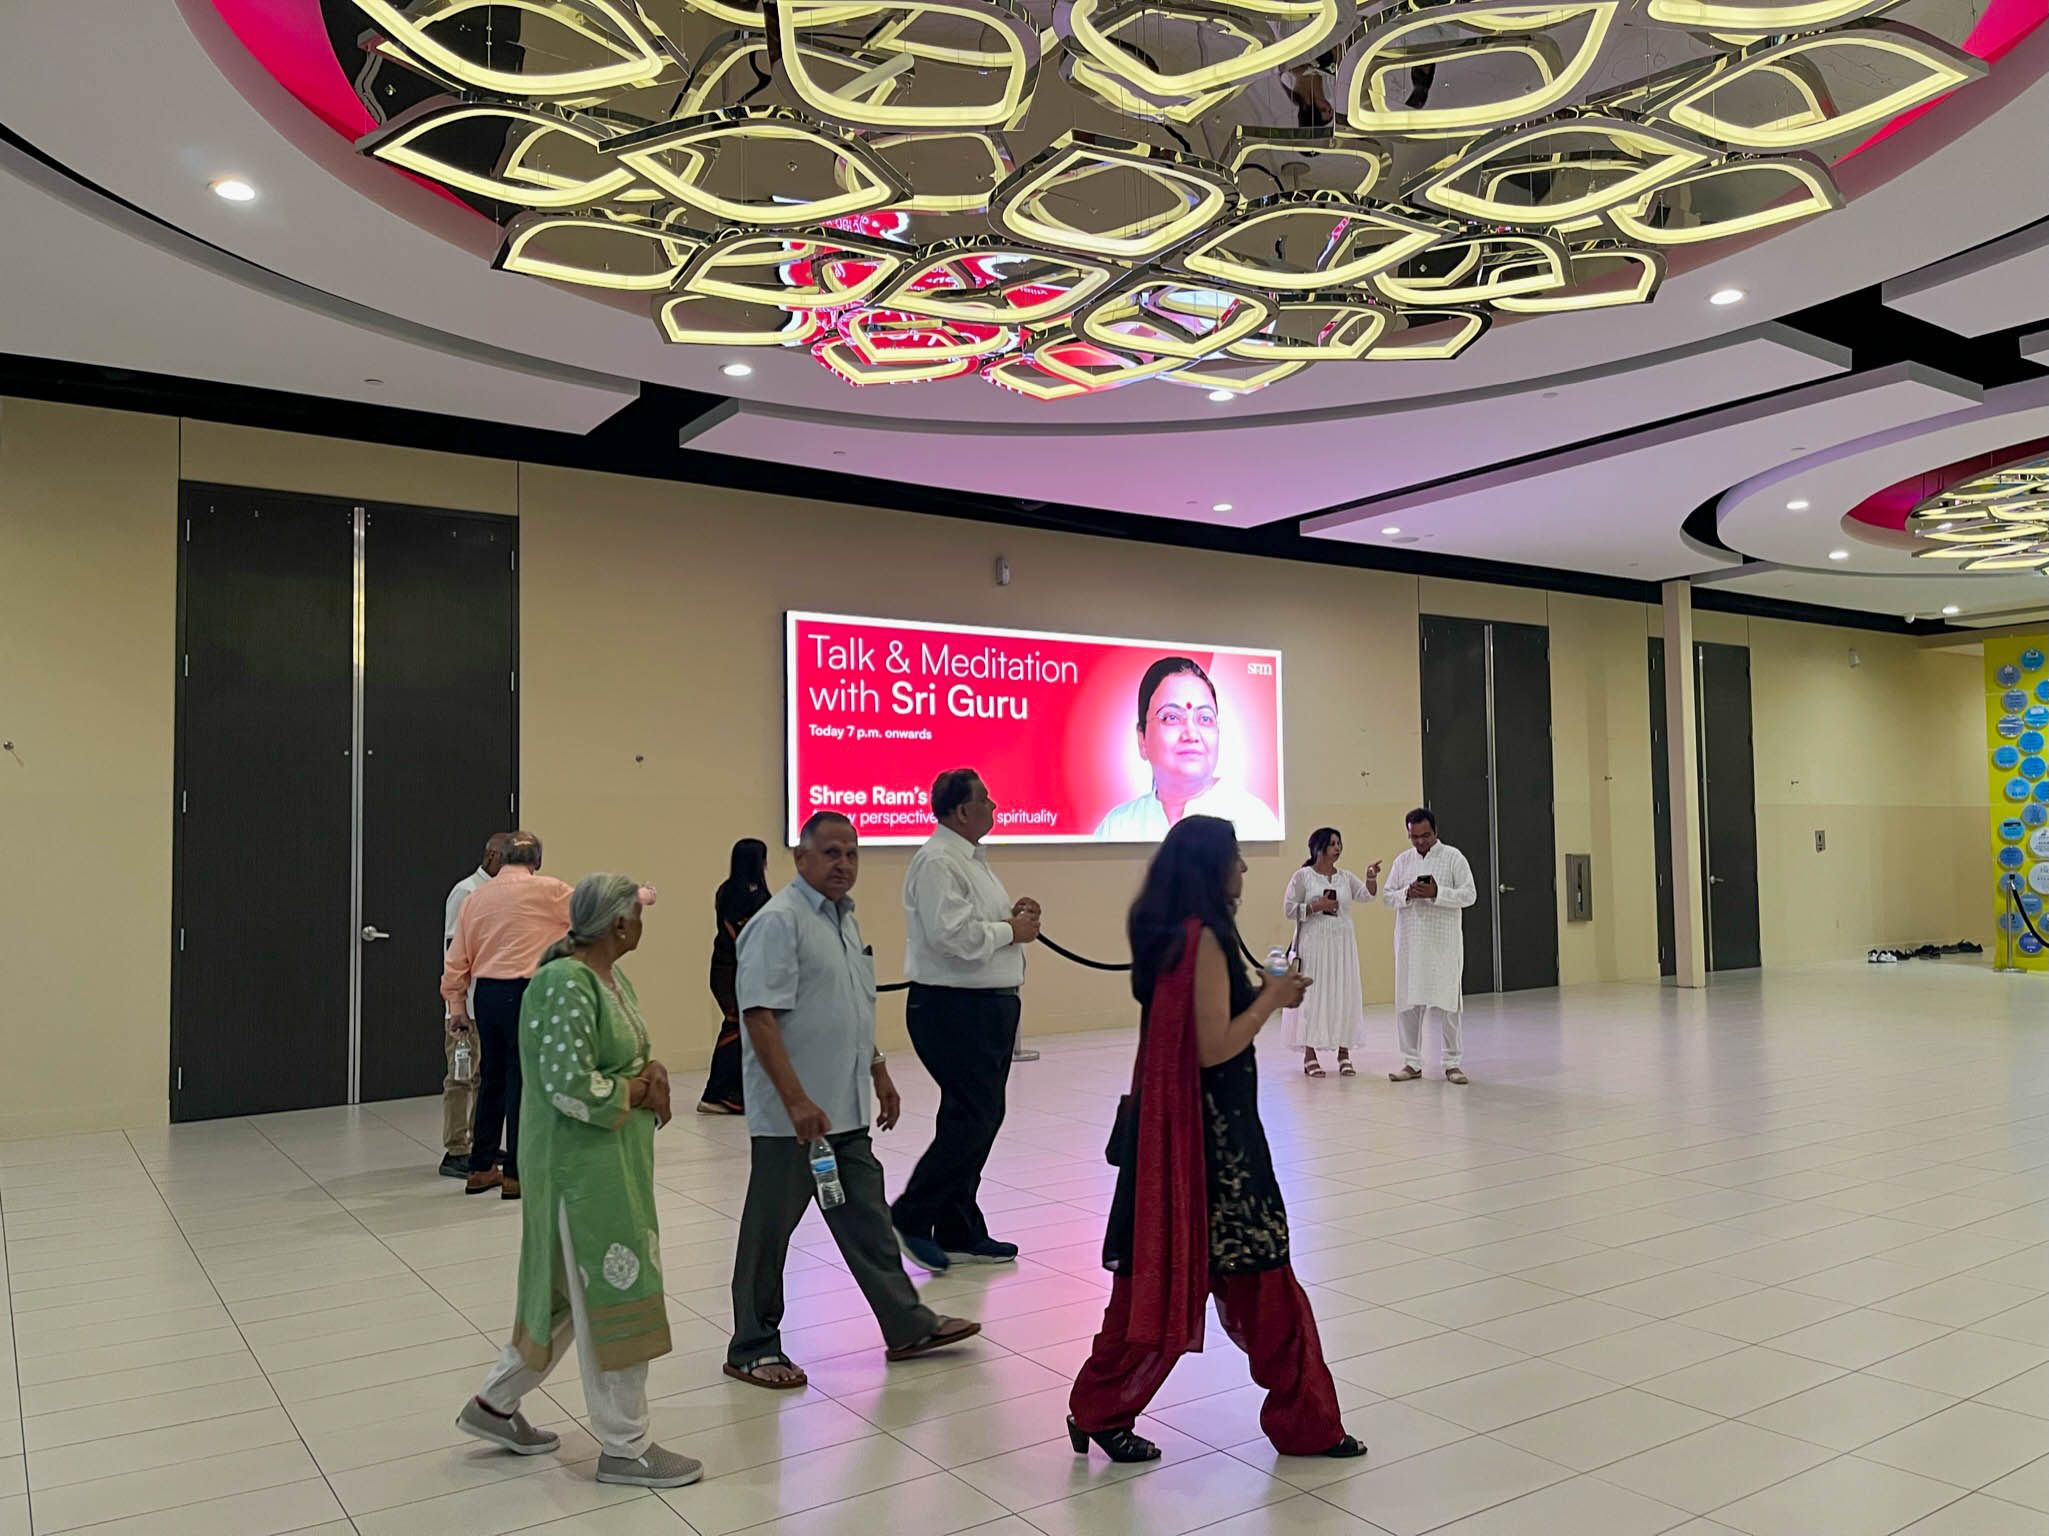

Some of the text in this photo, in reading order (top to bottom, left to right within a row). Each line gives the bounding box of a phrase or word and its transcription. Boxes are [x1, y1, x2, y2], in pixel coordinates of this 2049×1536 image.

[807, 633, 1078, 684] Talk & Meditation
[808, 678, 1028, 720] with Sri Guru
[808, 724, 932, 740] Today 7 p.m. onwards
[809, 785, 867, 805] Shree
[860, 809, 939, 827] perspective
[996, 808, 1057, 827] spirituality
